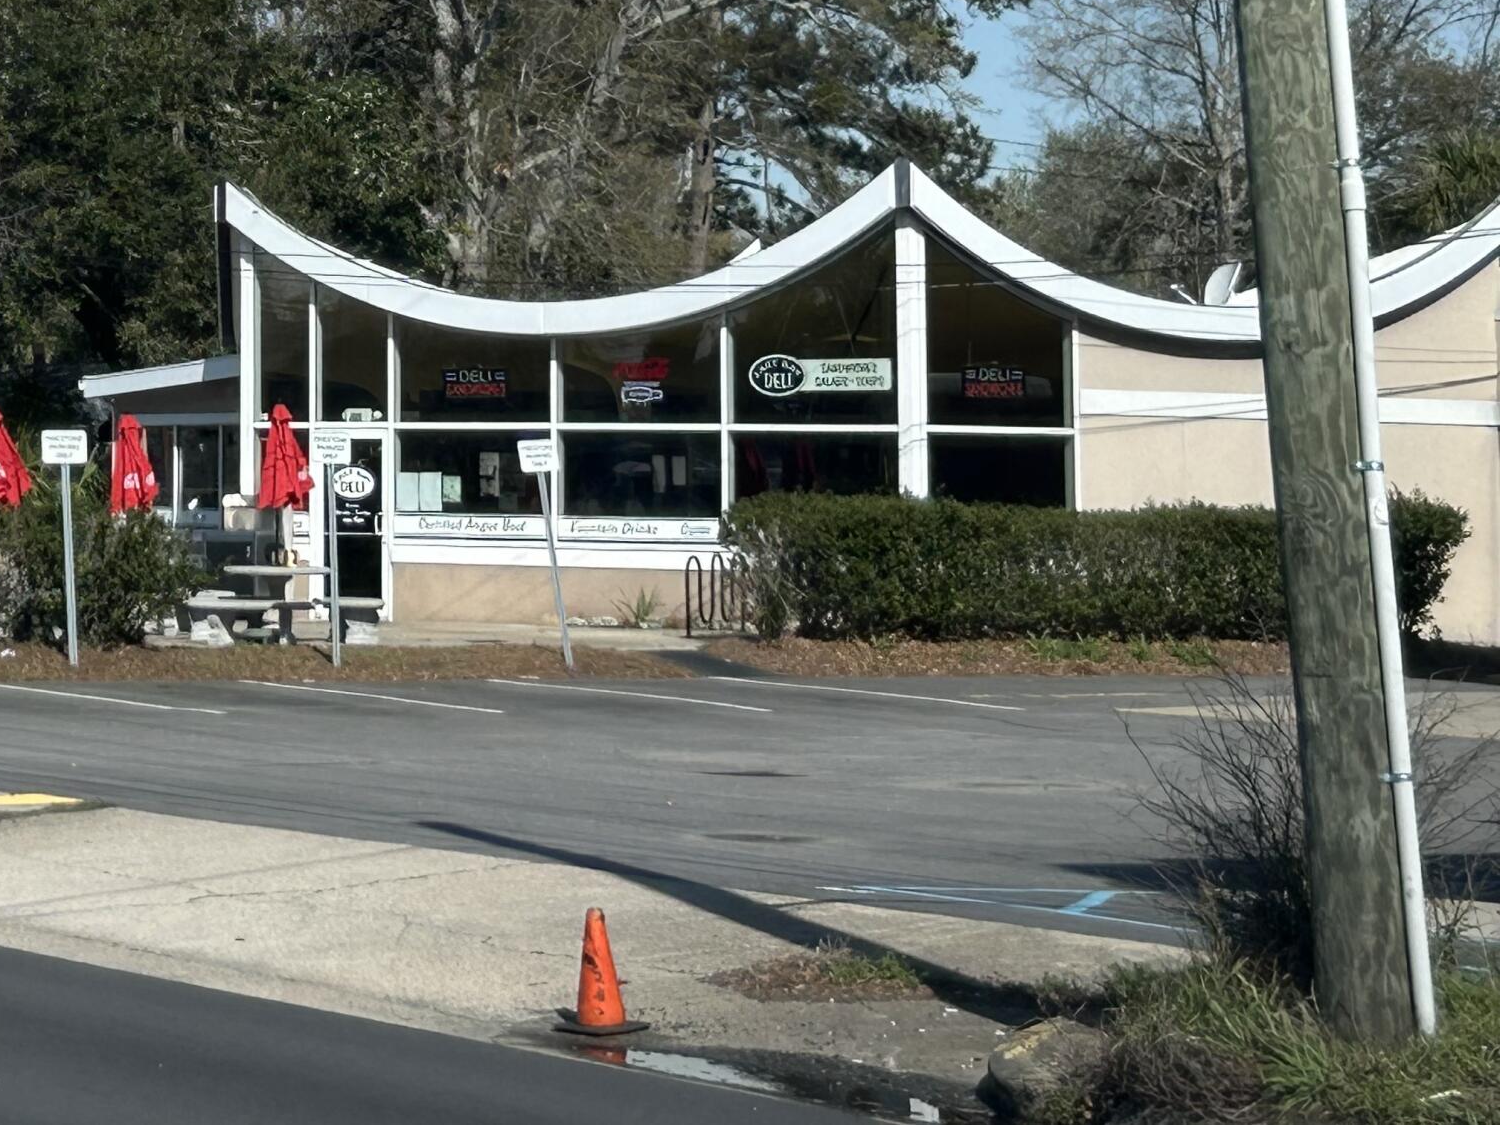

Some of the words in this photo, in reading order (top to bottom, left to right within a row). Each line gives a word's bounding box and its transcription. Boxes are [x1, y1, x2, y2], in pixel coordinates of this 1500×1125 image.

[459, 369, 493, 383] DELI
[764, 372, 793, 389] DELI
[978, 367, 1010, 382] DELI
